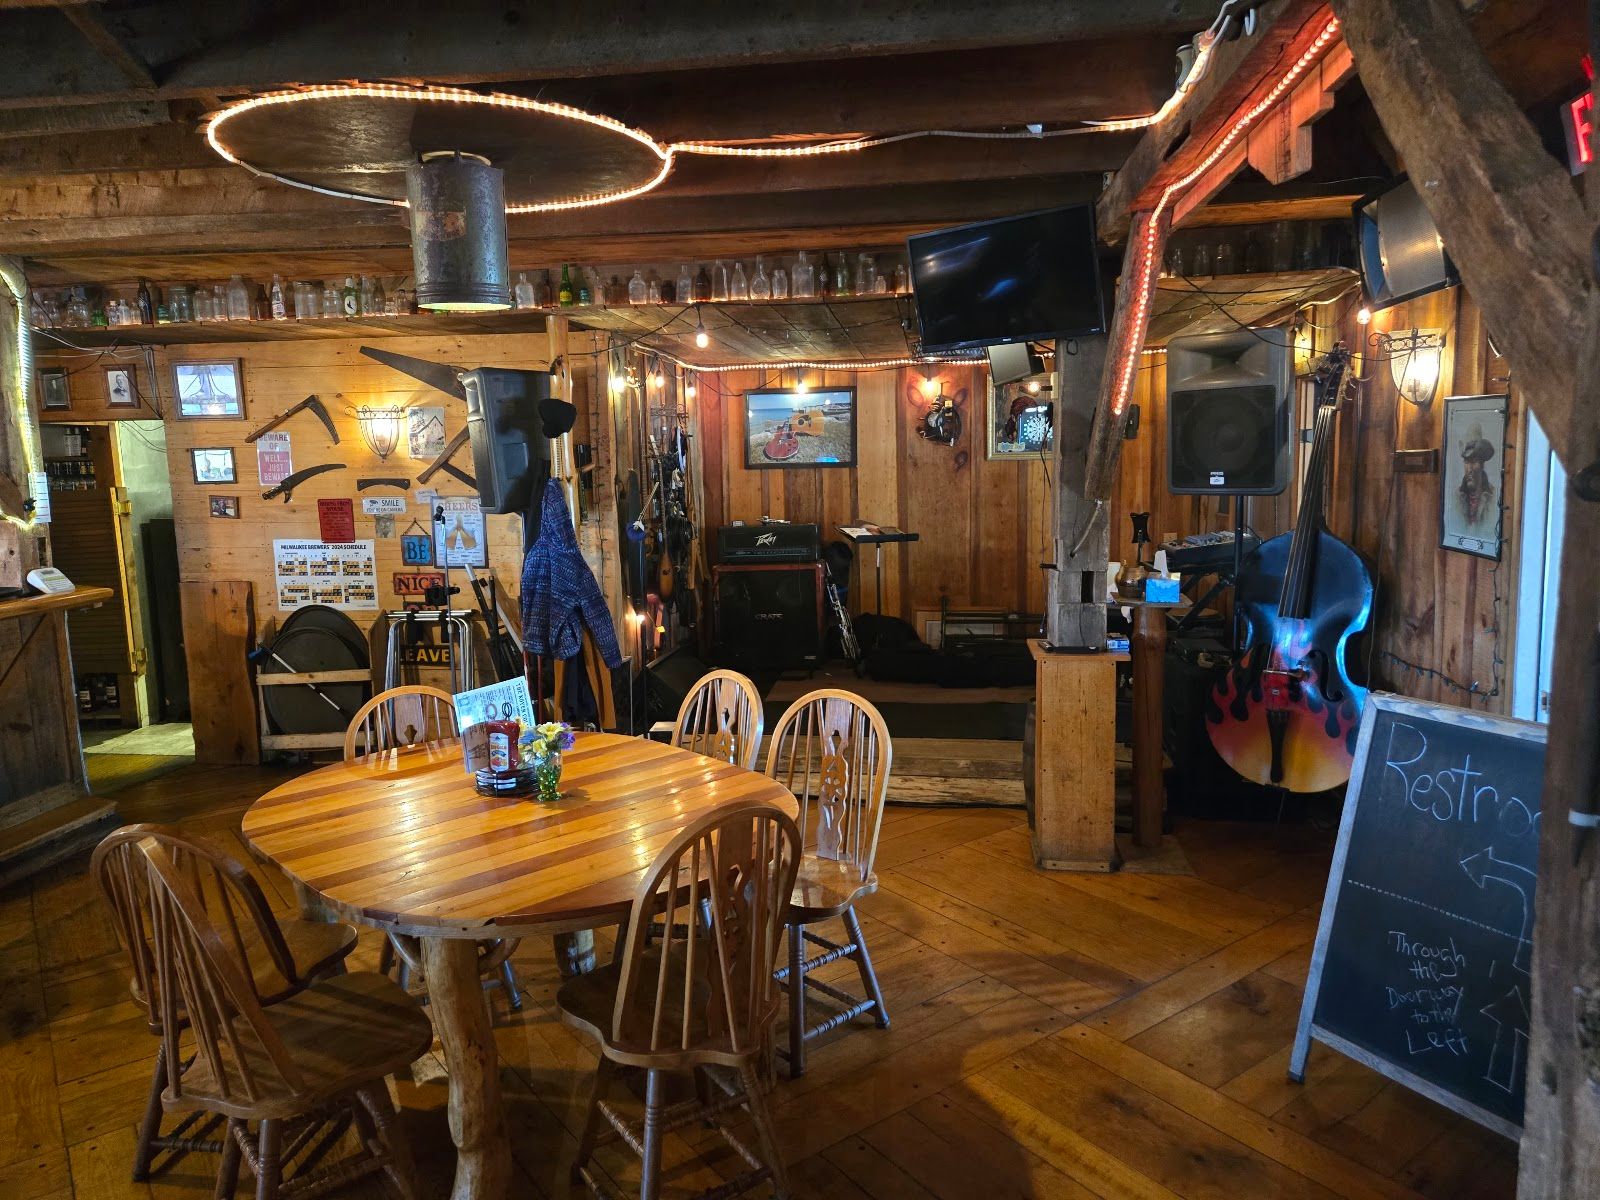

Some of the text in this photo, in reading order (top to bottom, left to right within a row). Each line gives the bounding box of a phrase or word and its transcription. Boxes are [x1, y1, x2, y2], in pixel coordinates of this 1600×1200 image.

[269, 442, 279, 450] OF
[269, 463, 283, 472] JUST
[381, 499, 399, 507] SMILE
[406, 541, 427, 560] BE
[397, 577, 440, 591] NICE
[402, 648, 450, 662] EAVE
[1388, 931, 1466, 976] Through
[1409, 960, 1442, 982] the
[1410, 1008, 1429, 1024] to
[1405, 1028, 1468, 1056] Left
